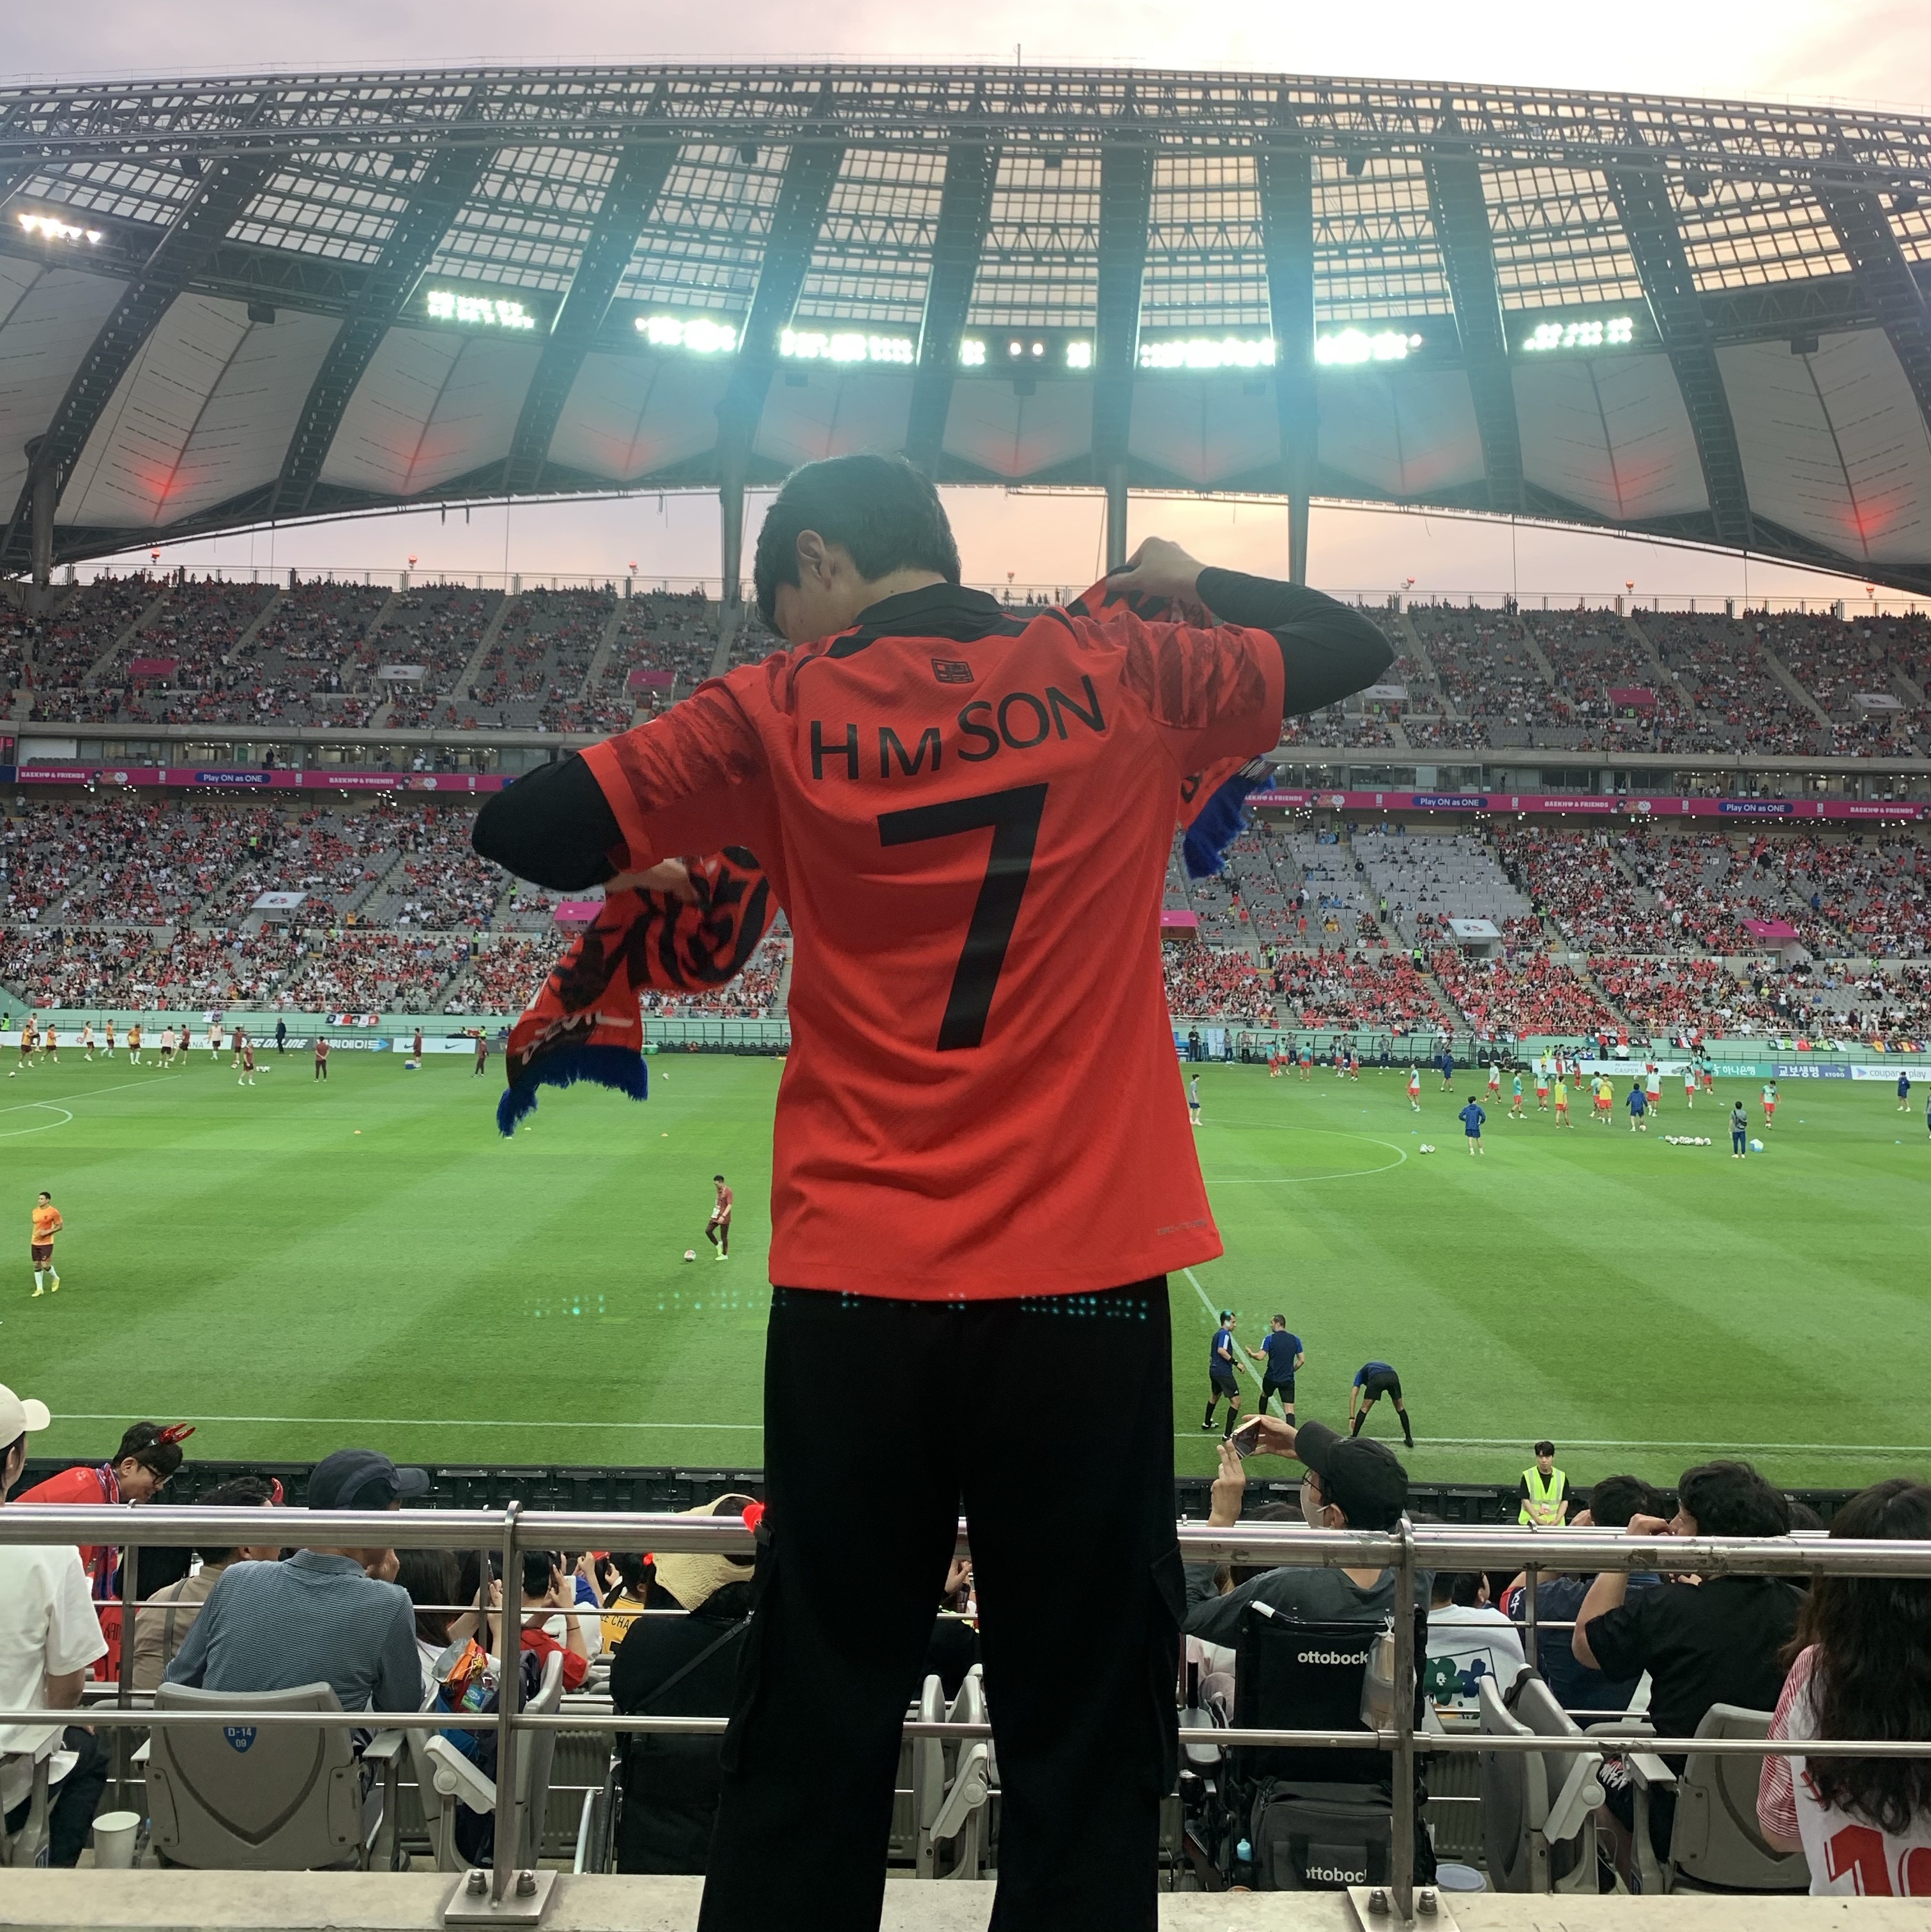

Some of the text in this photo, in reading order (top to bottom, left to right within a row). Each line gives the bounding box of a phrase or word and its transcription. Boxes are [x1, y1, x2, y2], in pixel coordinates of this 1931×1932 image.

[958, 674, 1106, 762] SON
[203, 773, 219, 782] Play
[245, 775, 263, 783] ONE
[1421, 798, 1436, 807] Play
[1727, 803, 1742, 812] Play
[876, 782, 1049, 1053] 7
[1723, 1065, 1755, 1076] 하나은행
[1778, 1065, 1820, 1078] 교보생명
[1870, 1067, 1927, 1080] coupan play
[1297, 1650, 1368, 1665] ottobock
[228, 1727, 252, 1737] D-14
[236, 1738, 247, 1747] 09
[1306, 1866, 1367, 1883] ttoboc
